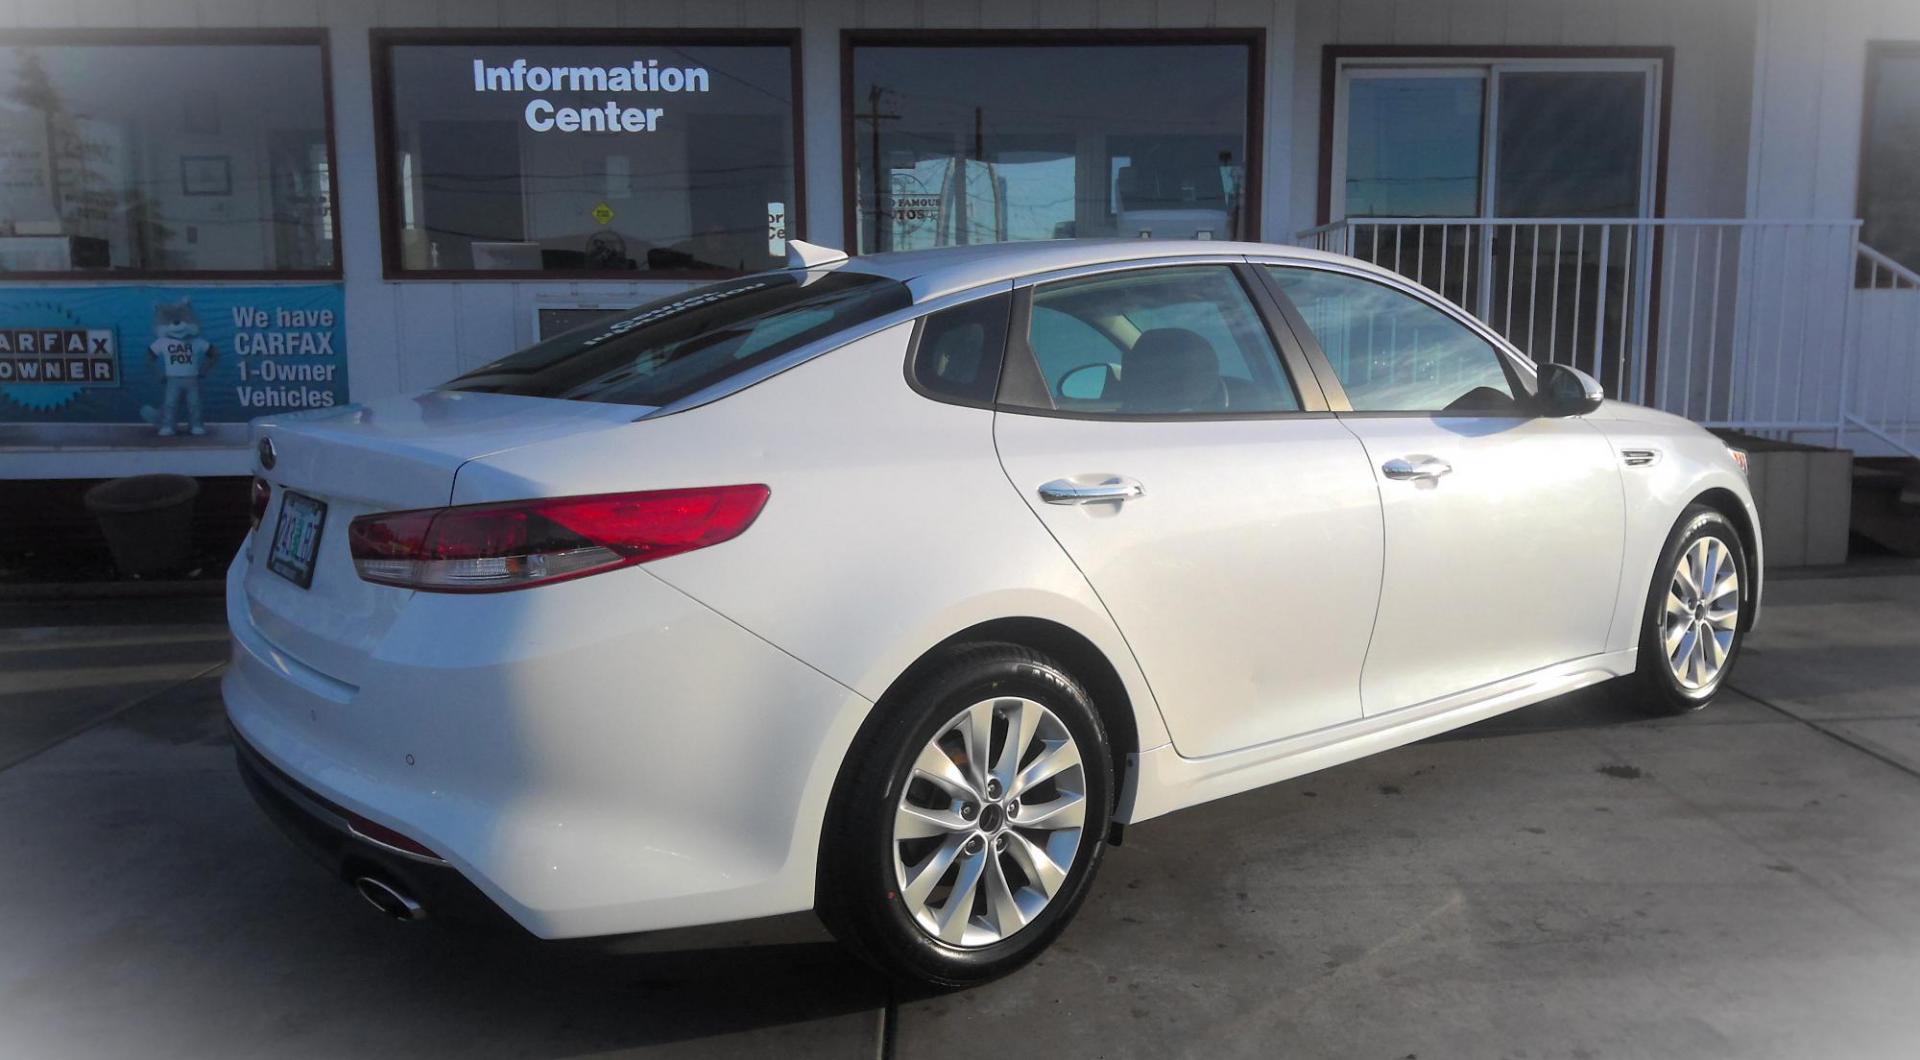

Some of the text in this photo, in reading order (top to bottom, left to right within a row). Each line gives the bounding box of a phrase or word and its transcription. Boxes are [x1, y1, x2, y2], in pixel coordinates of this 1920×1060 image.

[473, 59, 709, 92] Information
[525, 99, 664, 132] Center
[232, 306, 334, 328] We have
[167, 343, 193, 354] CAR
[234, 333, 334, 355] CARFAX
[0, 361, 112, 380] OWNER
[170, 354, 193, 365] FOX
[238, 360, 336, 382] 1-Owner
[237, 386, 335, 408] Vehicles
